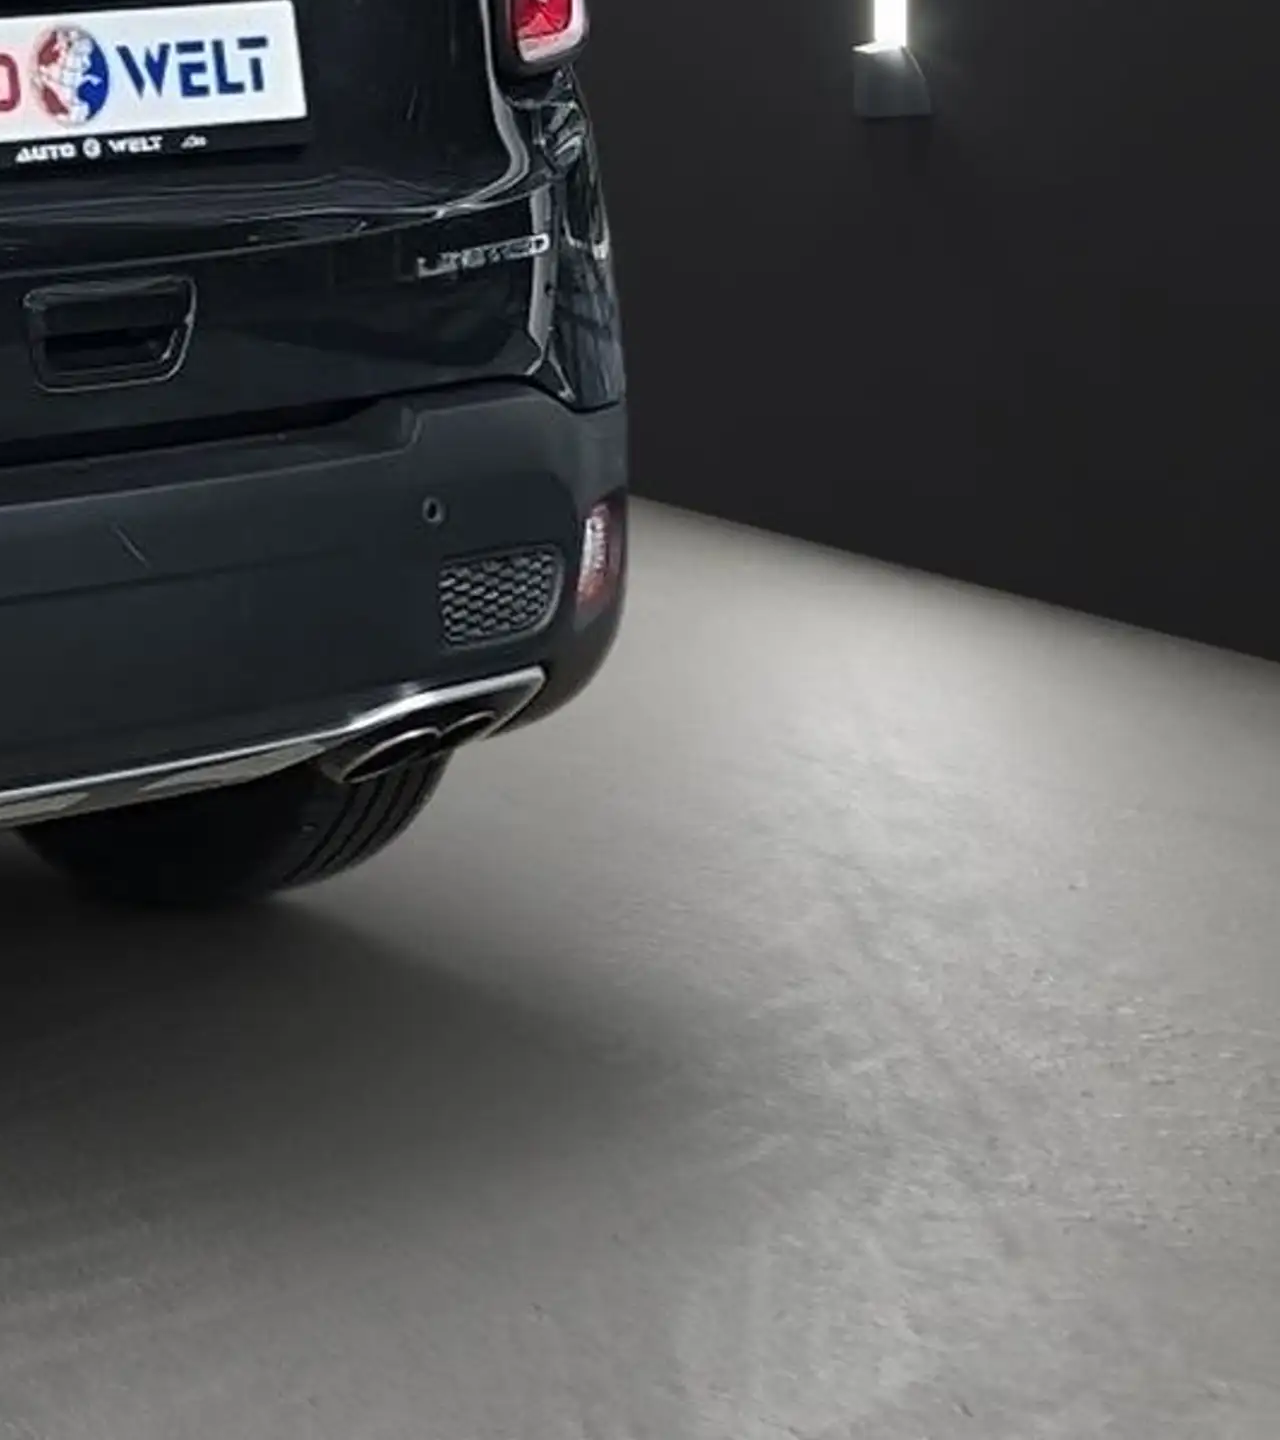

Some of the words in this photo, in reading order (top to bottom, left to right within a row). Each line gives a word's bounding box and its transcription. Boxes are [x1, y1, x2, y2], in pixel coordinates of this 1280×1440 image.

[116, 35, 269, 99] WELT
[14, 142, 77, 164] AUTO
[107, 135, 164, 154] WELT
